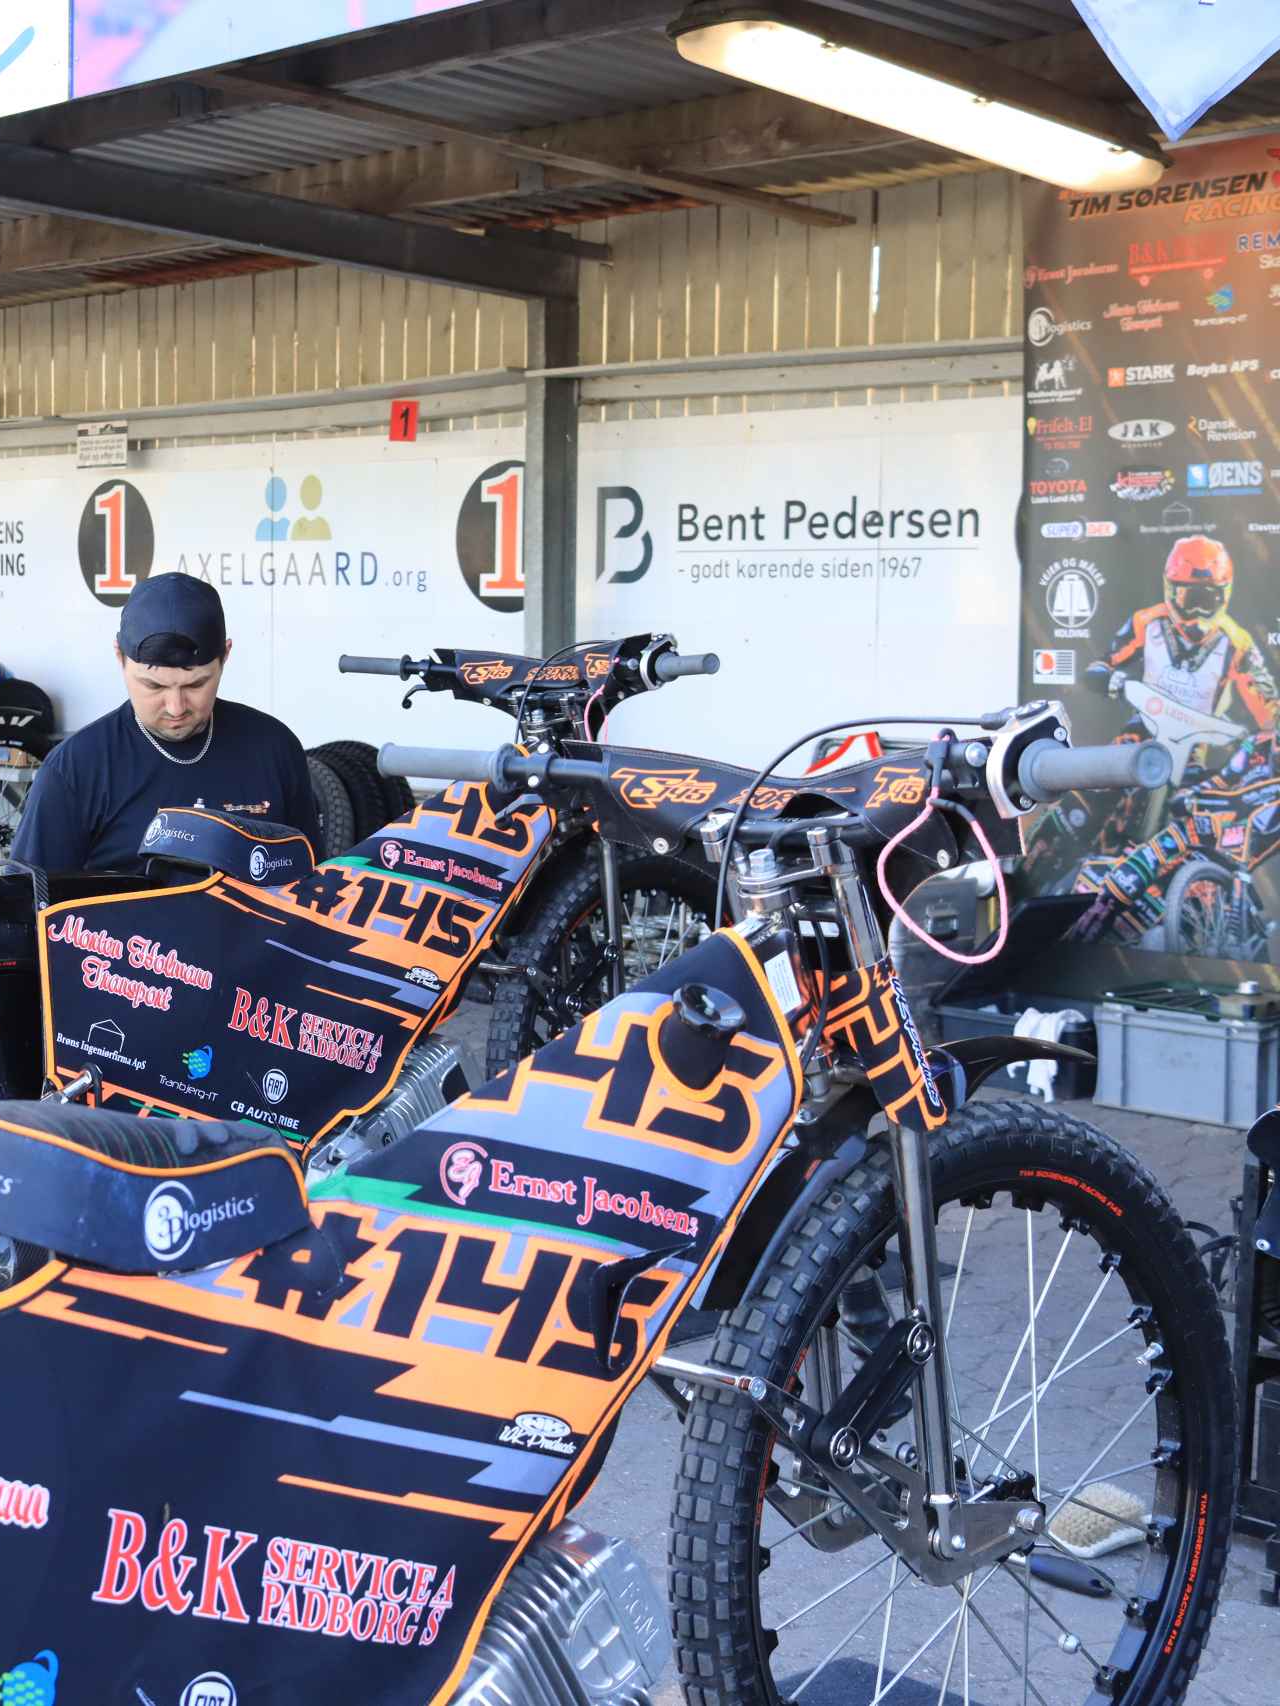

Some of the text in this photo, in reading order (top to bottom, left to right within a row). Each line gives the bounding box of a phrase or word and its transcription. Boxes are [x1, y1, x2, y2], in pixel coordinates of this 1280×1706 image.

[1070, 193, 1111, 217] TIM
[1126, 364, 1175, 381] STARK
[399, 407, 410, 438] 1
[1121, 422, 1161, 438] JAK
[1198, 418, 1238, 433] Dansk
[1207, 427, 1257, 441] Revision
[1030, 479, 1088, 495] TOYOTA
[479, 466, 525, 597] 1
[677, 495, 980, 542] Bent Pedersen
[95, 484, 137, 594] 1
[690, 560, 731, 584] godt
[737, 558, 814, 579] kørende
[821, 557, 873, 579] siden
[880, 556, 922, 578] 1967
[157, 825, 196, 842] logistics
[403, 849, 498, 891] Ernst Jacobsen
[288, 868, 488, 959] #145
[48, 914, 124, 960] Morten
[81, 956, 173, 1012] Transport
[228, 987, 298, 1050] B&K
[300, 1012, 375, 1052] SERVICE
[56, 1032, 80, 1049] Brøns
[132, 1058, 147, 1071] ApS
[297, 1030, 368, 1070] PADBORG
[230, 1100, 301, 1131] CB AUTO RIBE
[183, 1195, 256, 1234] logistics
[488, 1158, 577, 1205] Ernst
[577, 1175, 690, 1236] Jacobsen
[92, 1507, 259, 1624] B&K
[262, 1536, 435, 1604] SERVICE
[258, 1578, 419, 1645] PADBORG
